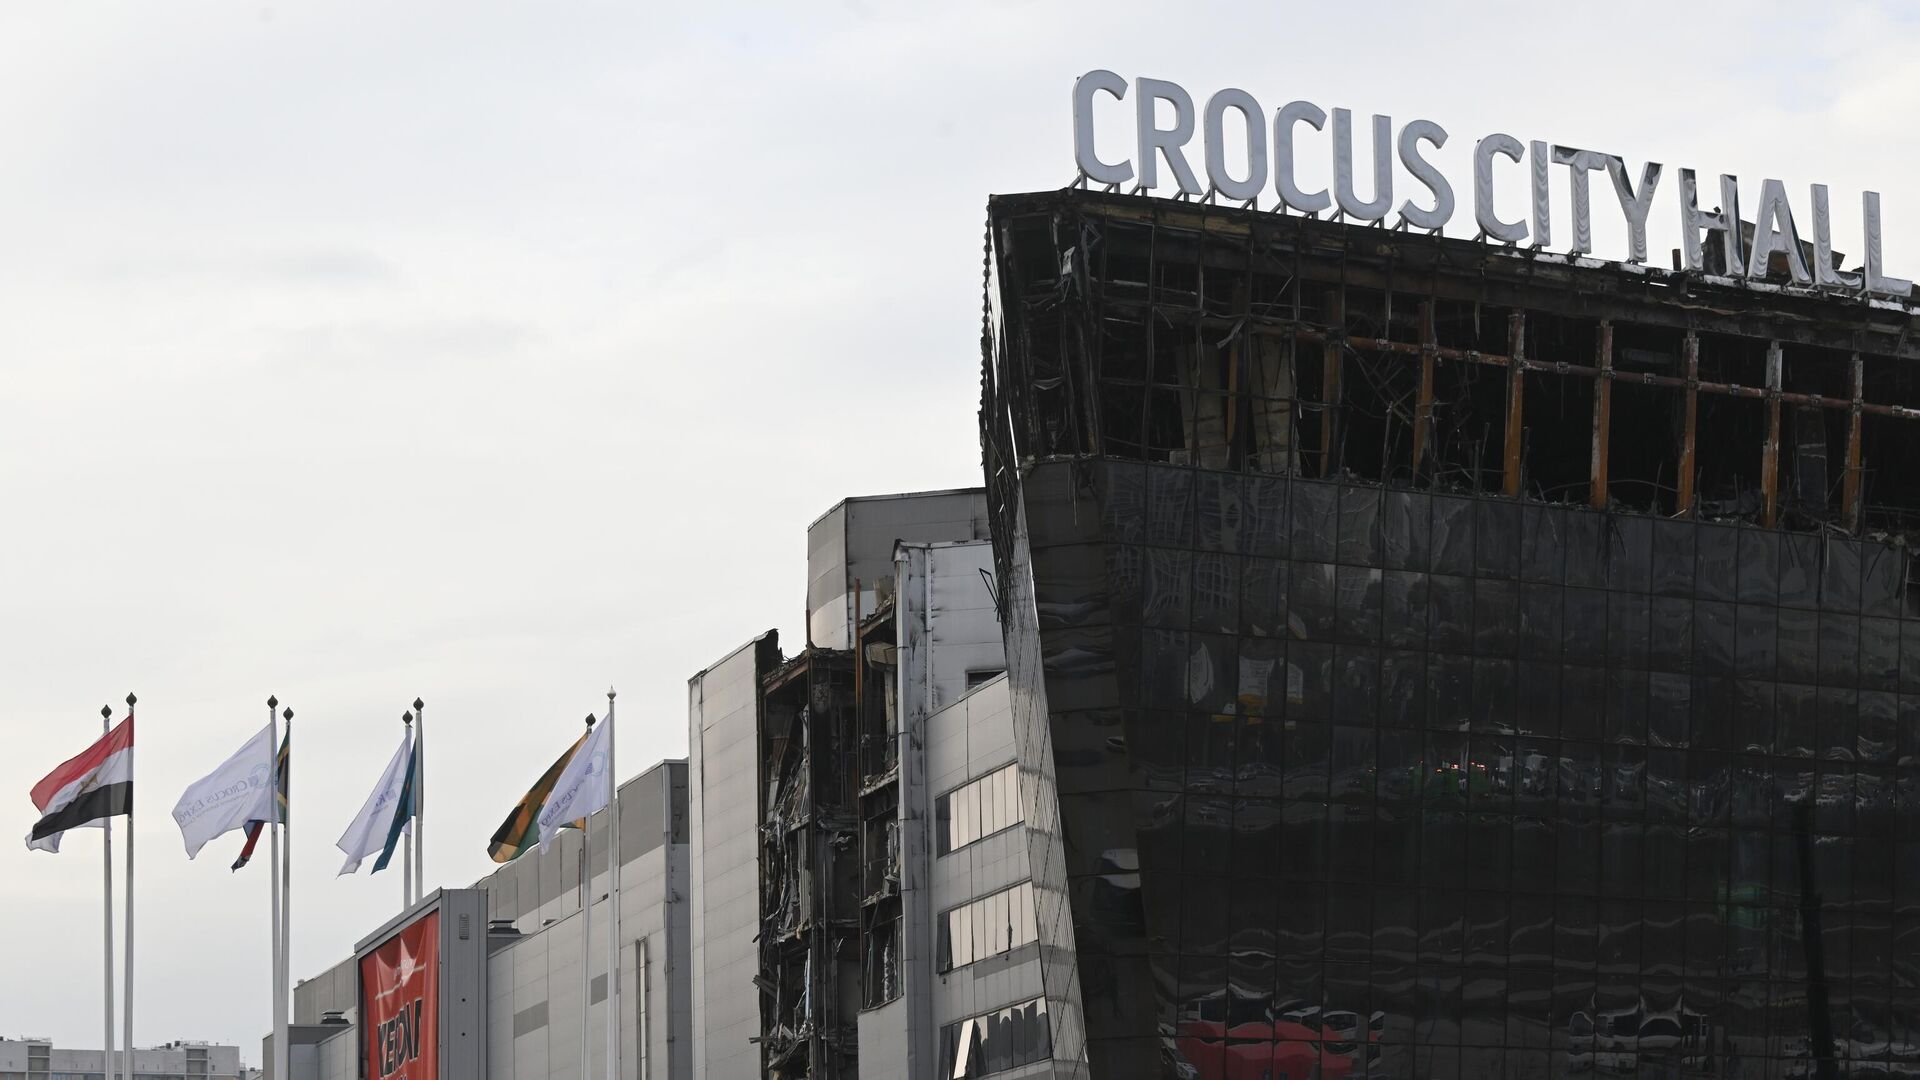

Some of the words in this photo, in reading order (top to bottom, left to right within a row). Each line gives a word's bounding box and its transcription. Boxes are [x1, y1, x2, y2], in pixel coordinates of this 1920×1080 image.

[1073, 69, 1454, 229] CROCUS
[1474, 133, 1663, 263] CITY
[1678, 167, 1912, 297] HALL
